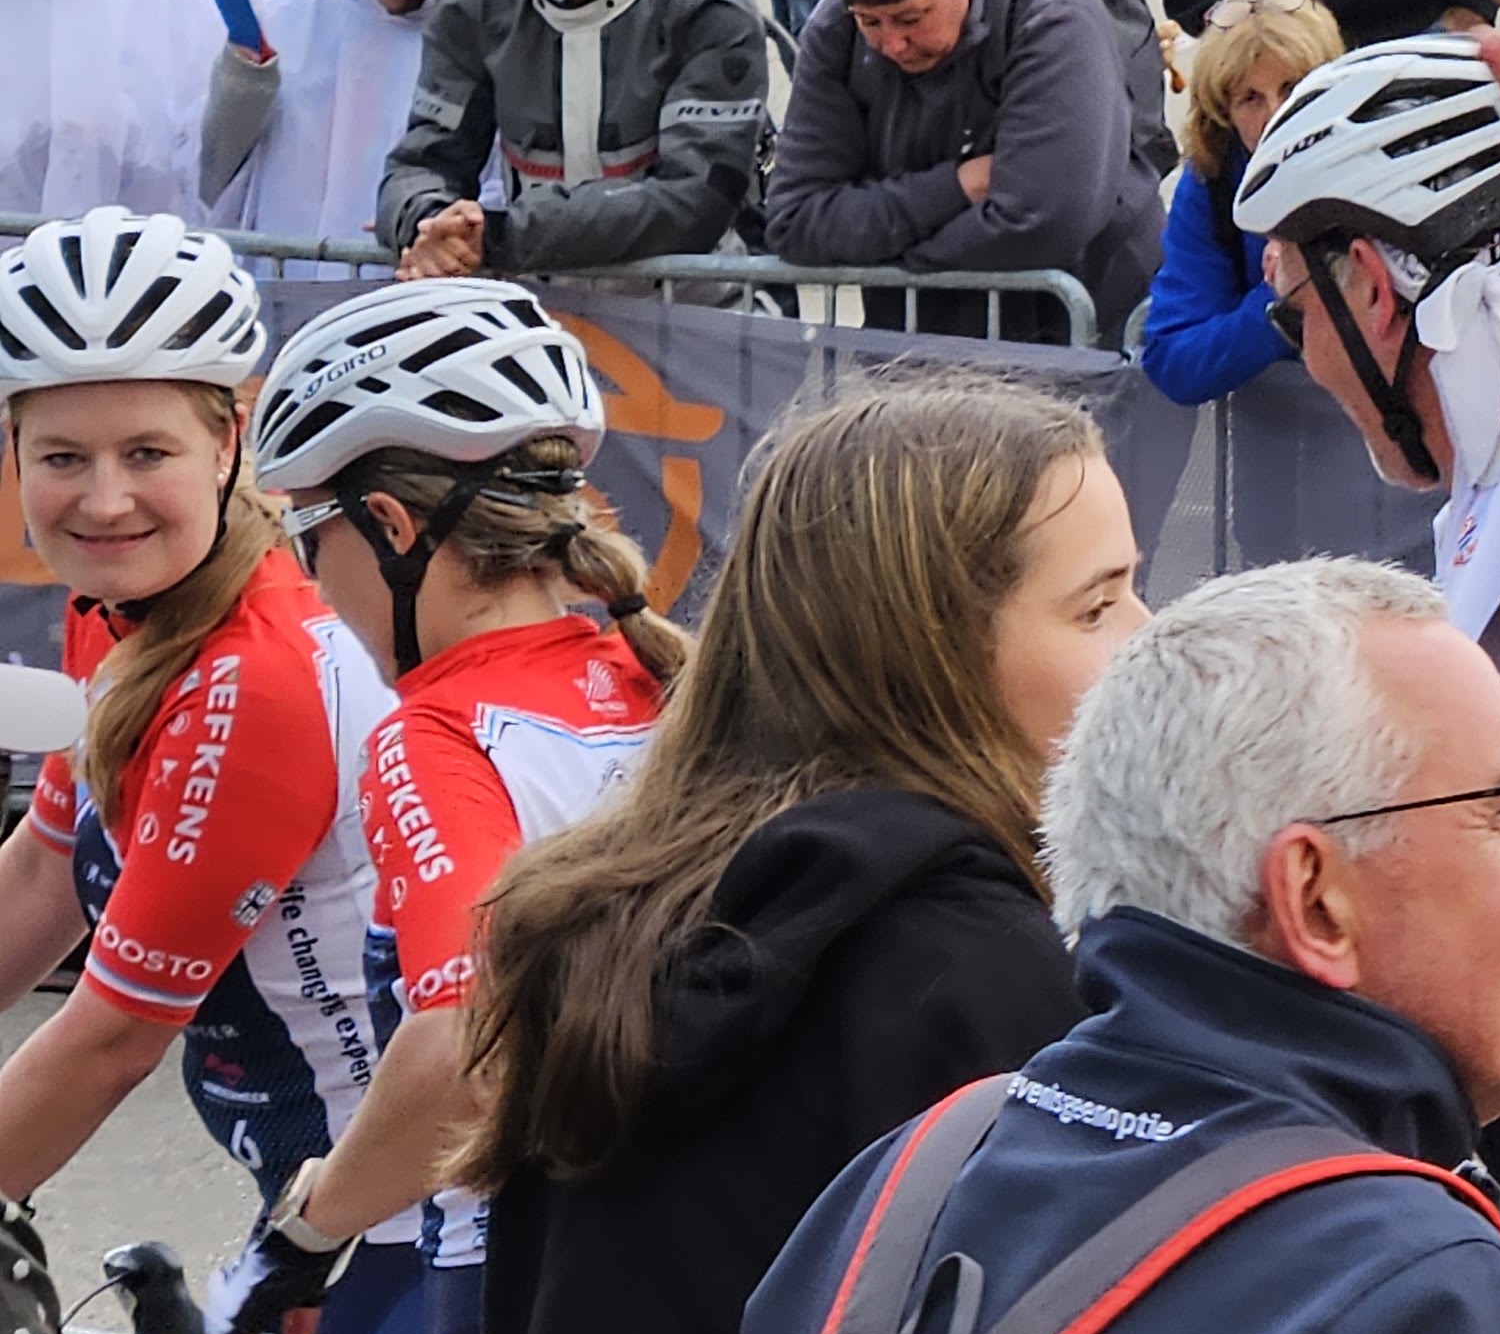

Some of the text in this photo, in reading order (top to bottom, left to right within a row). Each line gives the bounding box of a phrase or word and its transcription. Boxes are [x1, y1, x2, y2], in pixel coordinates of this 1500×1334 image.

[327, 344, 387, 383] GIRO
[167, 654, 241, 866] NEFKENS
[377, 719, 454, 885] NEFKENS
